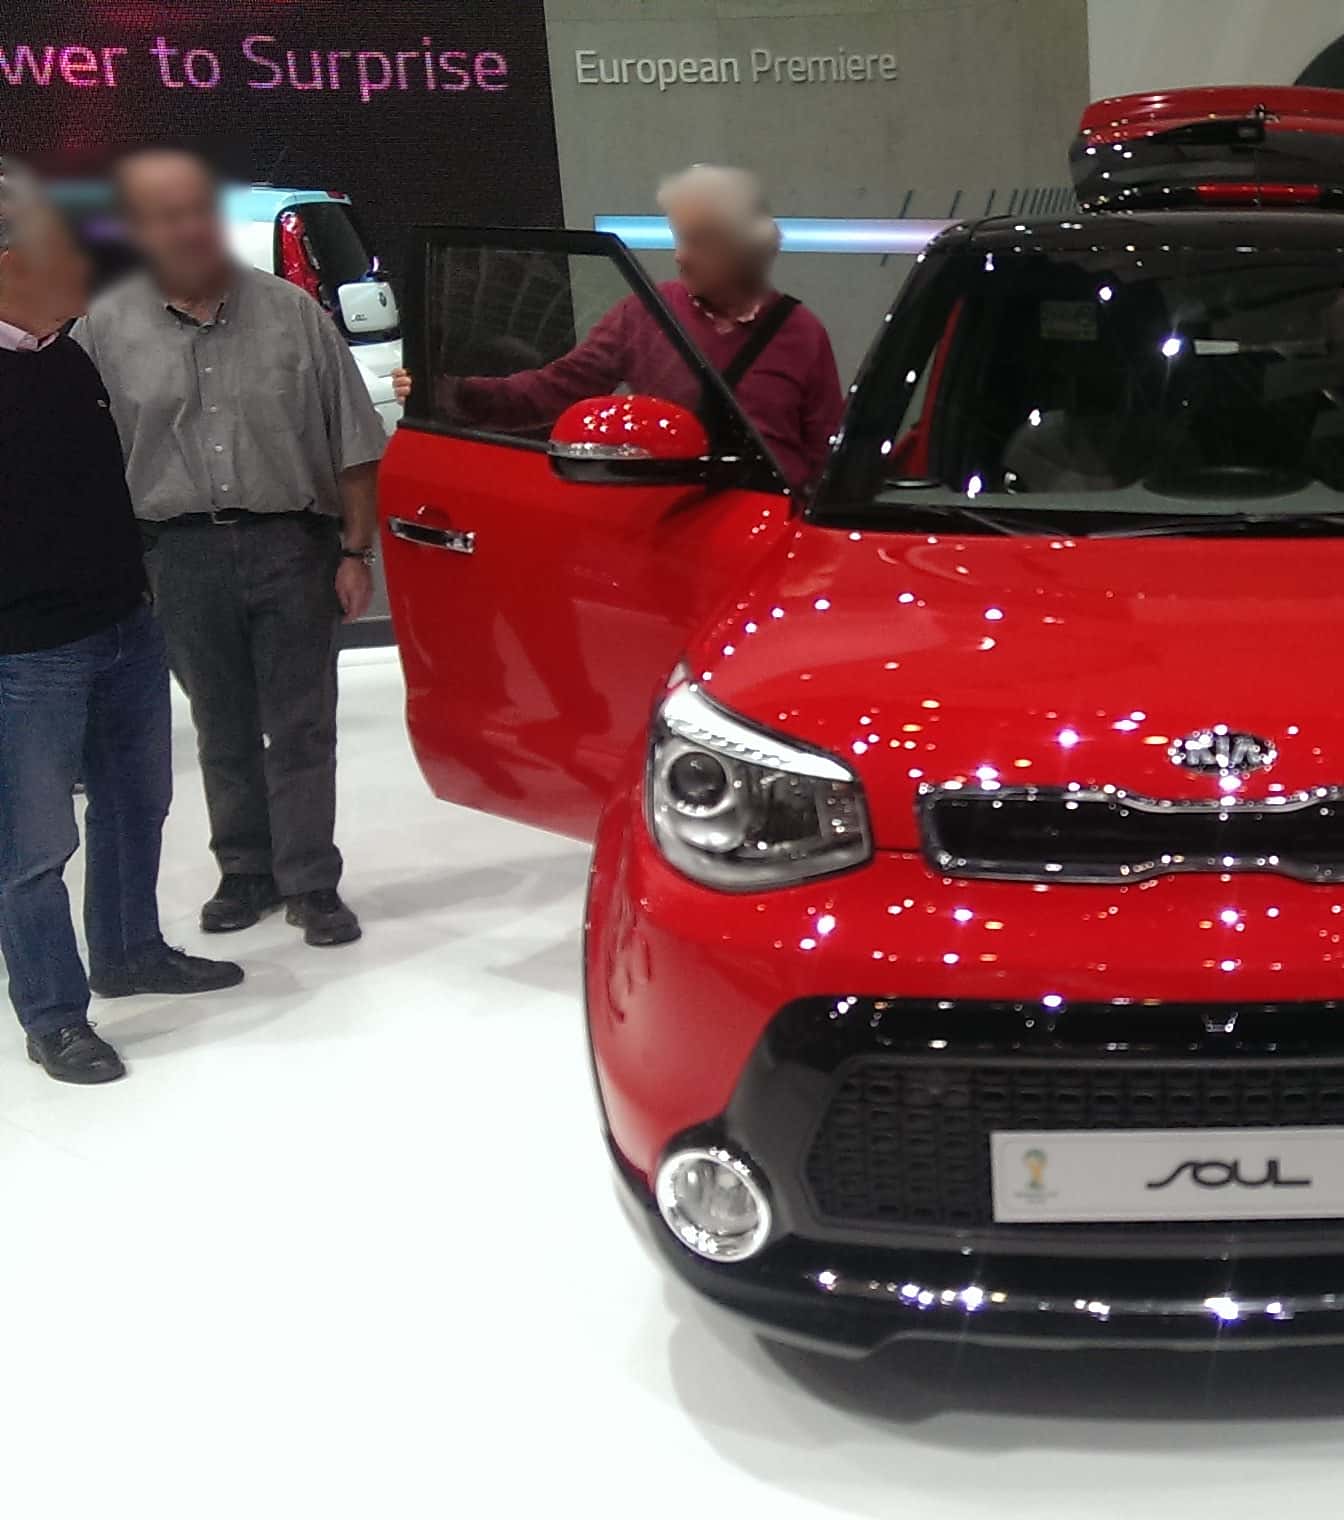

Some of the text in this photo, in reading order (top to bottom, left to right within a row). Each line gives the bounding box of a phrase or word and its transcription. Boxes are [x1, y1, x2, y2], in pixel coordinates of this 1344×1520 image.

[150, 36, 222, 88] to
[242, 35, 509, 103] Surprise
[575, 47, 897, 91] European Premiere
[1184, 735, 1264, 767] KIA
[1146, 1158, 1312, 1190] SOUL
